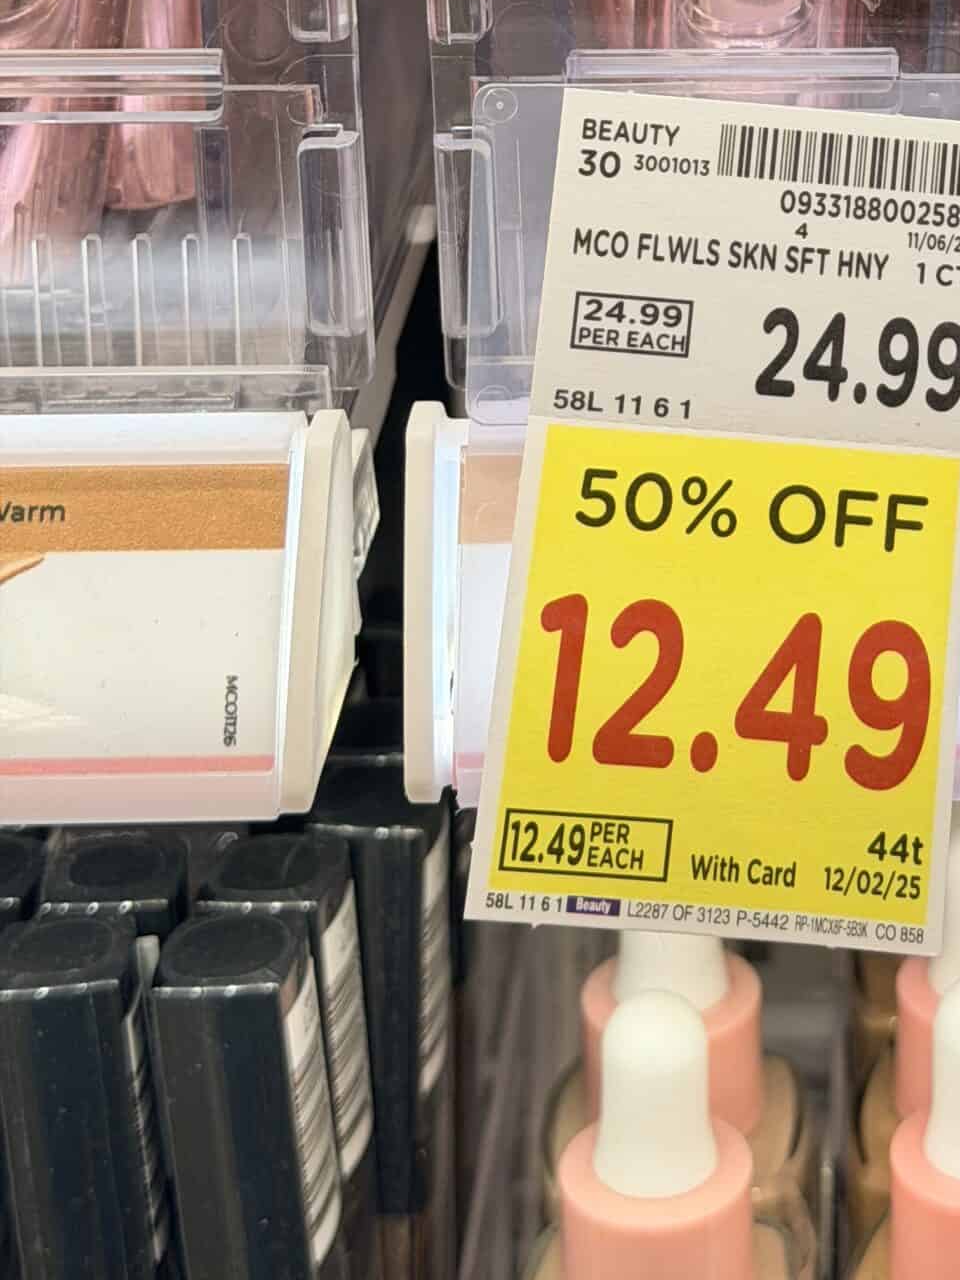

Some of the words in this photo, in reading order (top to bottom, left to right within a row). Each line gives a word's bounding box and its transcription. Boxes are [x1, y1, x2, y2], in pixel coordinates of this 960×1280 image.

[581, 119, 680, 147] BEAUTY
[578, 149, 621, 178] 30
[633, 153, 711, 177] 3001013
[795, 222, 809, 239] 4
[573, 227, 629, 259] MCO
[638, 233, 720, 267] FLWLS
[728, 241, 778, 272] SKN
[784, 246, 830, 276] SFT
[838, 250, 889, 281] HNY
[916, 262, 926, 285] 1
[582, 298, 683, 328] 24.99
[578, 326, 619, 348] PER
[626, 330, 686, 353] EACH
[553, 389, 604, 413] 58L
[615, 395, 641, 416] 11
[653, 397, 669, 418] 6
[680, 399, 691, 420] 1
[575, 468, 738, 538] 50%
[768, 484, 929, 552] OFF
[540, 593, 931, 791] 12.49
[510, 820, 586, 866] 12.49
[589, 822, 629, 845] PER
[867, 831, 924, 865] 44t
[586, 848, 645, 871] EACH
[690, 854, 742, 884] With
[747, 859, 797, 888] Card
[824, 866, 921, 900] 12/02/25
[485, 892, 513, 910] 58L
[519, 896, 535, 911] 11
[541, 897, 550, 912] 6
[576, 897, 612, 916] Beauty
[627, 901, 667, 920] L2287
[672, 904, 694, 921] OF
[697, 907, 731, 925] 3123
[736, 910, 789, 932] P-5442
[875, 923, 896, 942] CO
[900, 926, 925, 944] 858
